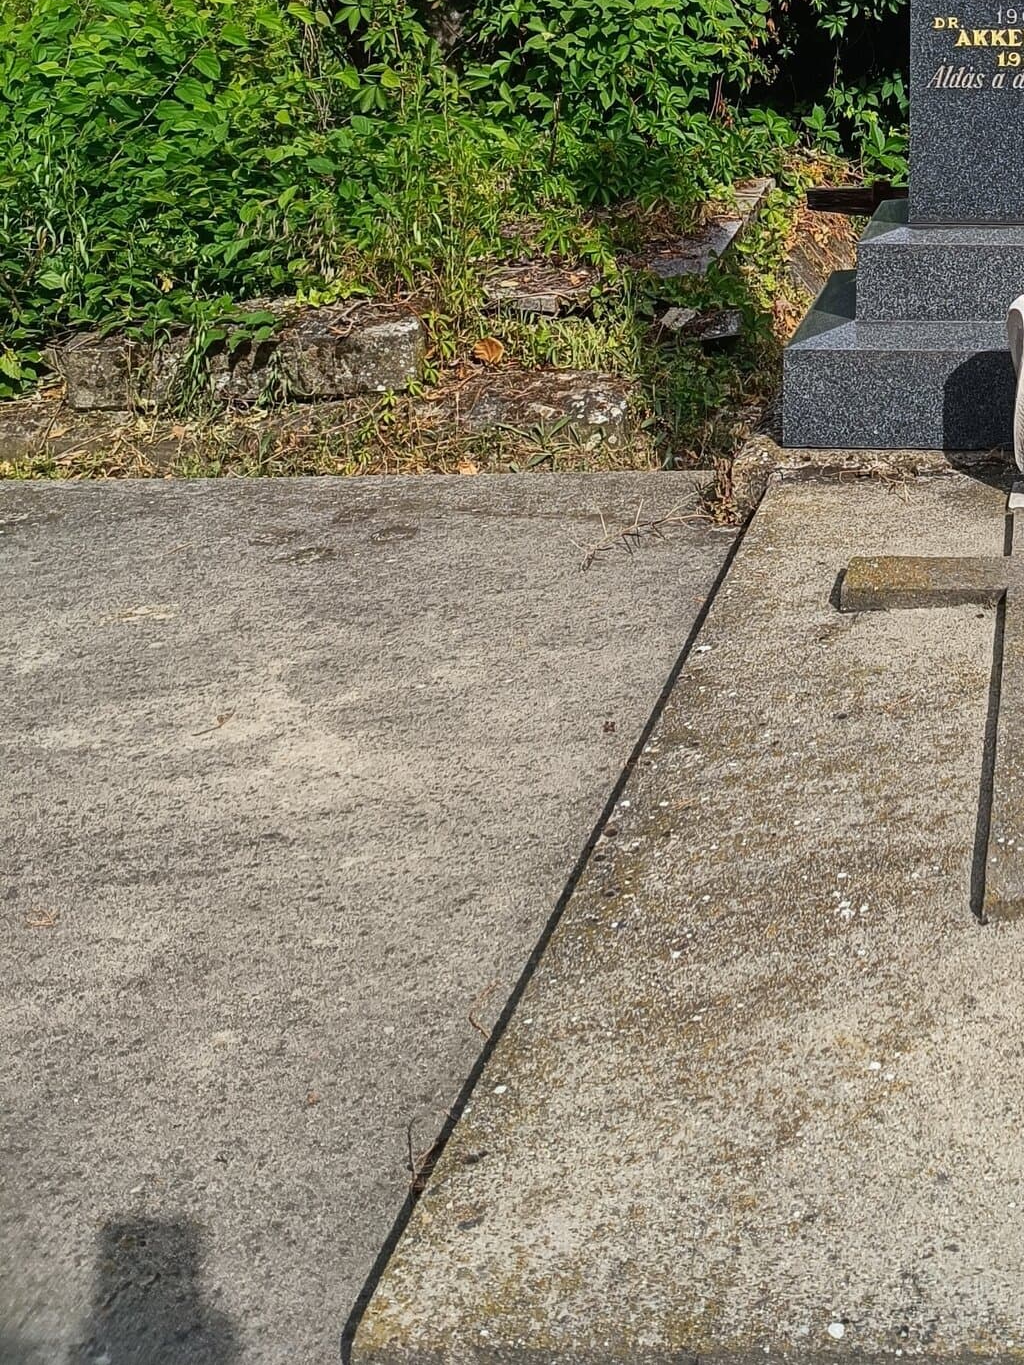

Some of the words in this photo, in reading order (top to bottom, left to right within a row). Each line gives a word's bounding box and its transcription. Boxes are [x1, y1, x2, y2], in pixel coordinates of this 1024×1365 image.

[934, 17, 964, 29] DR.
[927, 58, 985, 89] Áldás
[992, 71, 1005, 89] a
